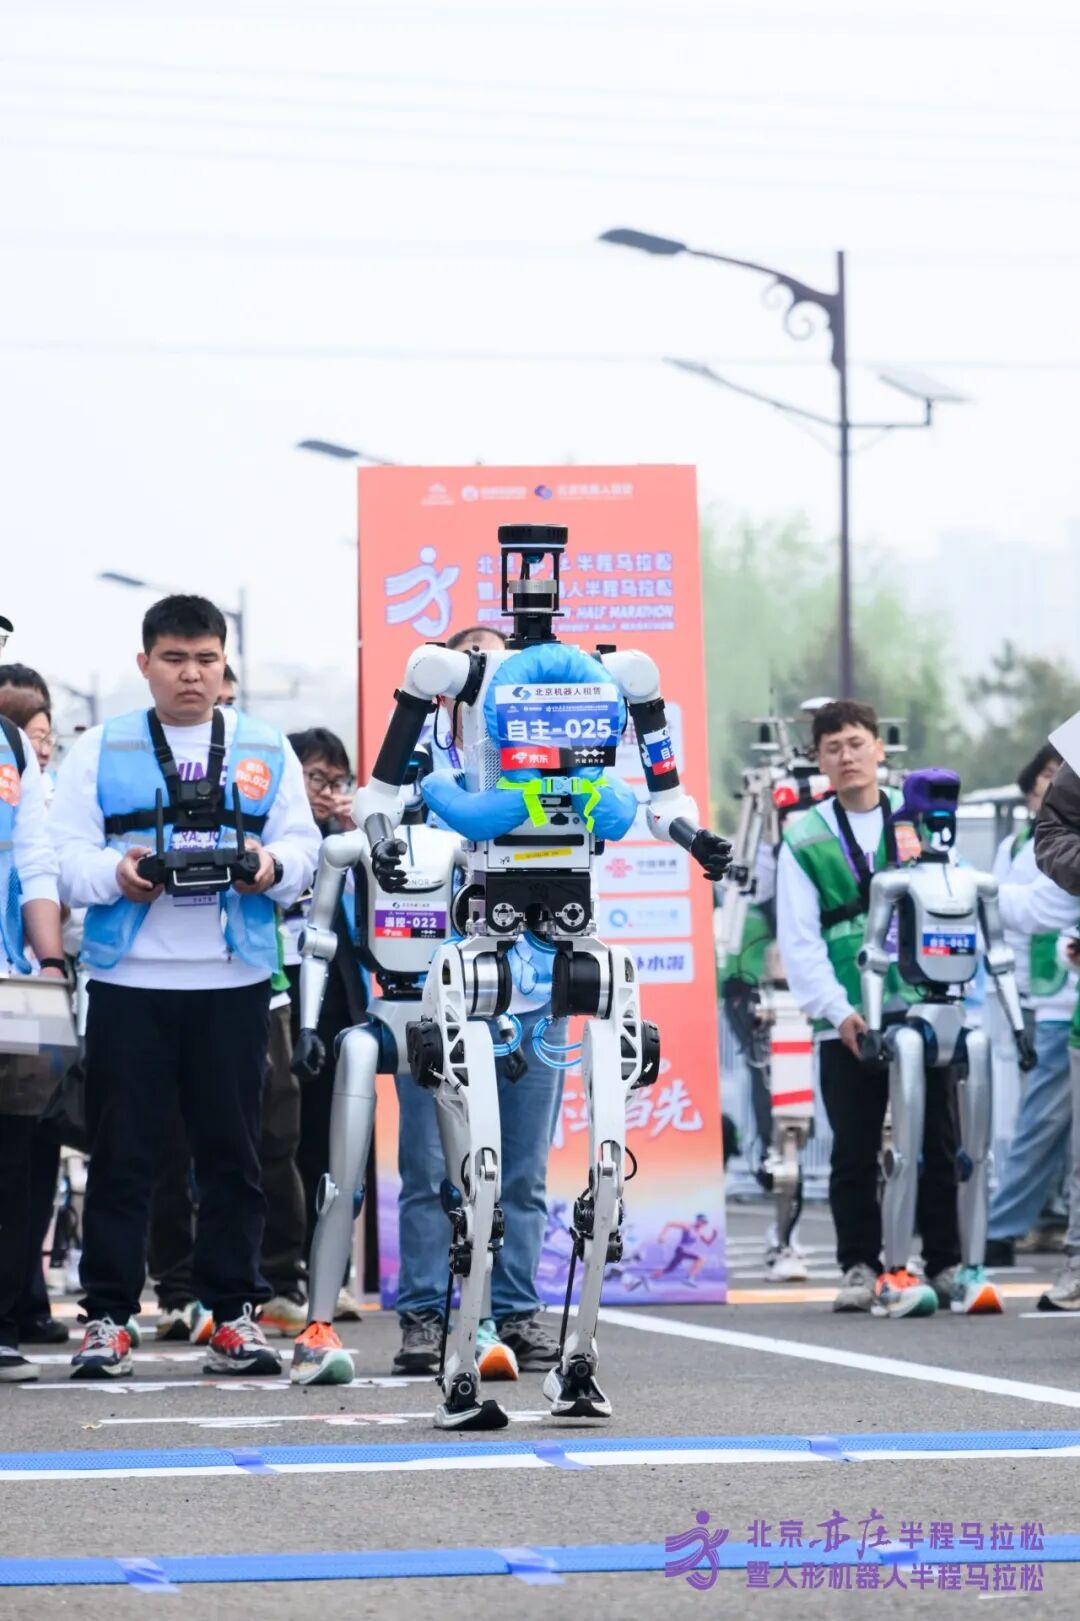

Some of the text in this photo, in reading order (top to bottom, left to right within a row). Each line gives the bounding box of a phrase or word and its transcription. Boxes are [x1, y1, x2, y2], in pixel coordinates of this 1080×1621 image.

[535, 686, 601, 697] 北京机器人租赁
[507, 718, 612, 741] 自主-025
[528, 754, 549, 765] 京东
